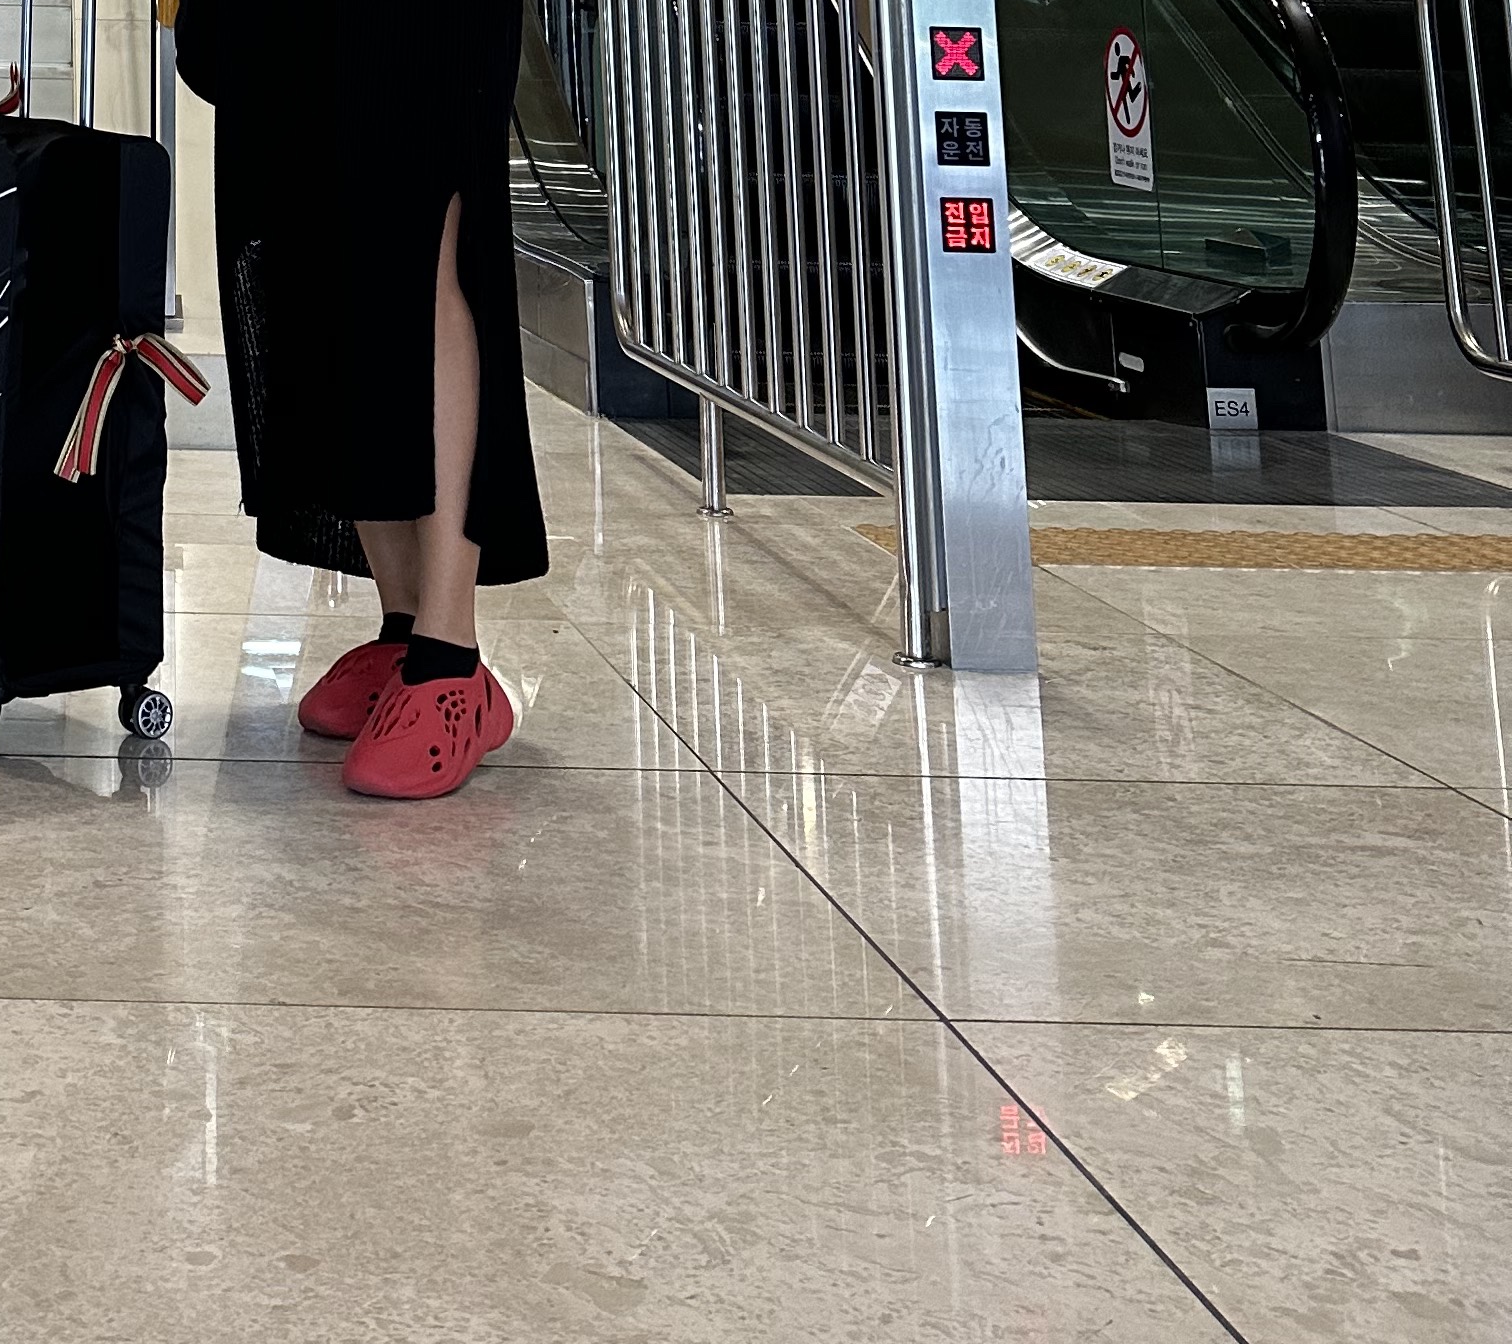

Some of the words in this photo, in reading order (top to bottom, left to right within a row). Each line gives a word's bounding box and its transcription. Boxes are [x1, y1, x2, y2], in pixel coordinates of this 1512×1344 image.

[940, 116, 983, 138] 자동
[941, 140, 985, 161] 운전
[944, 201, 990, 225] 진입
[945, 226, 991, 249] 금지
[1214, 400, 1250, 417] ES4
